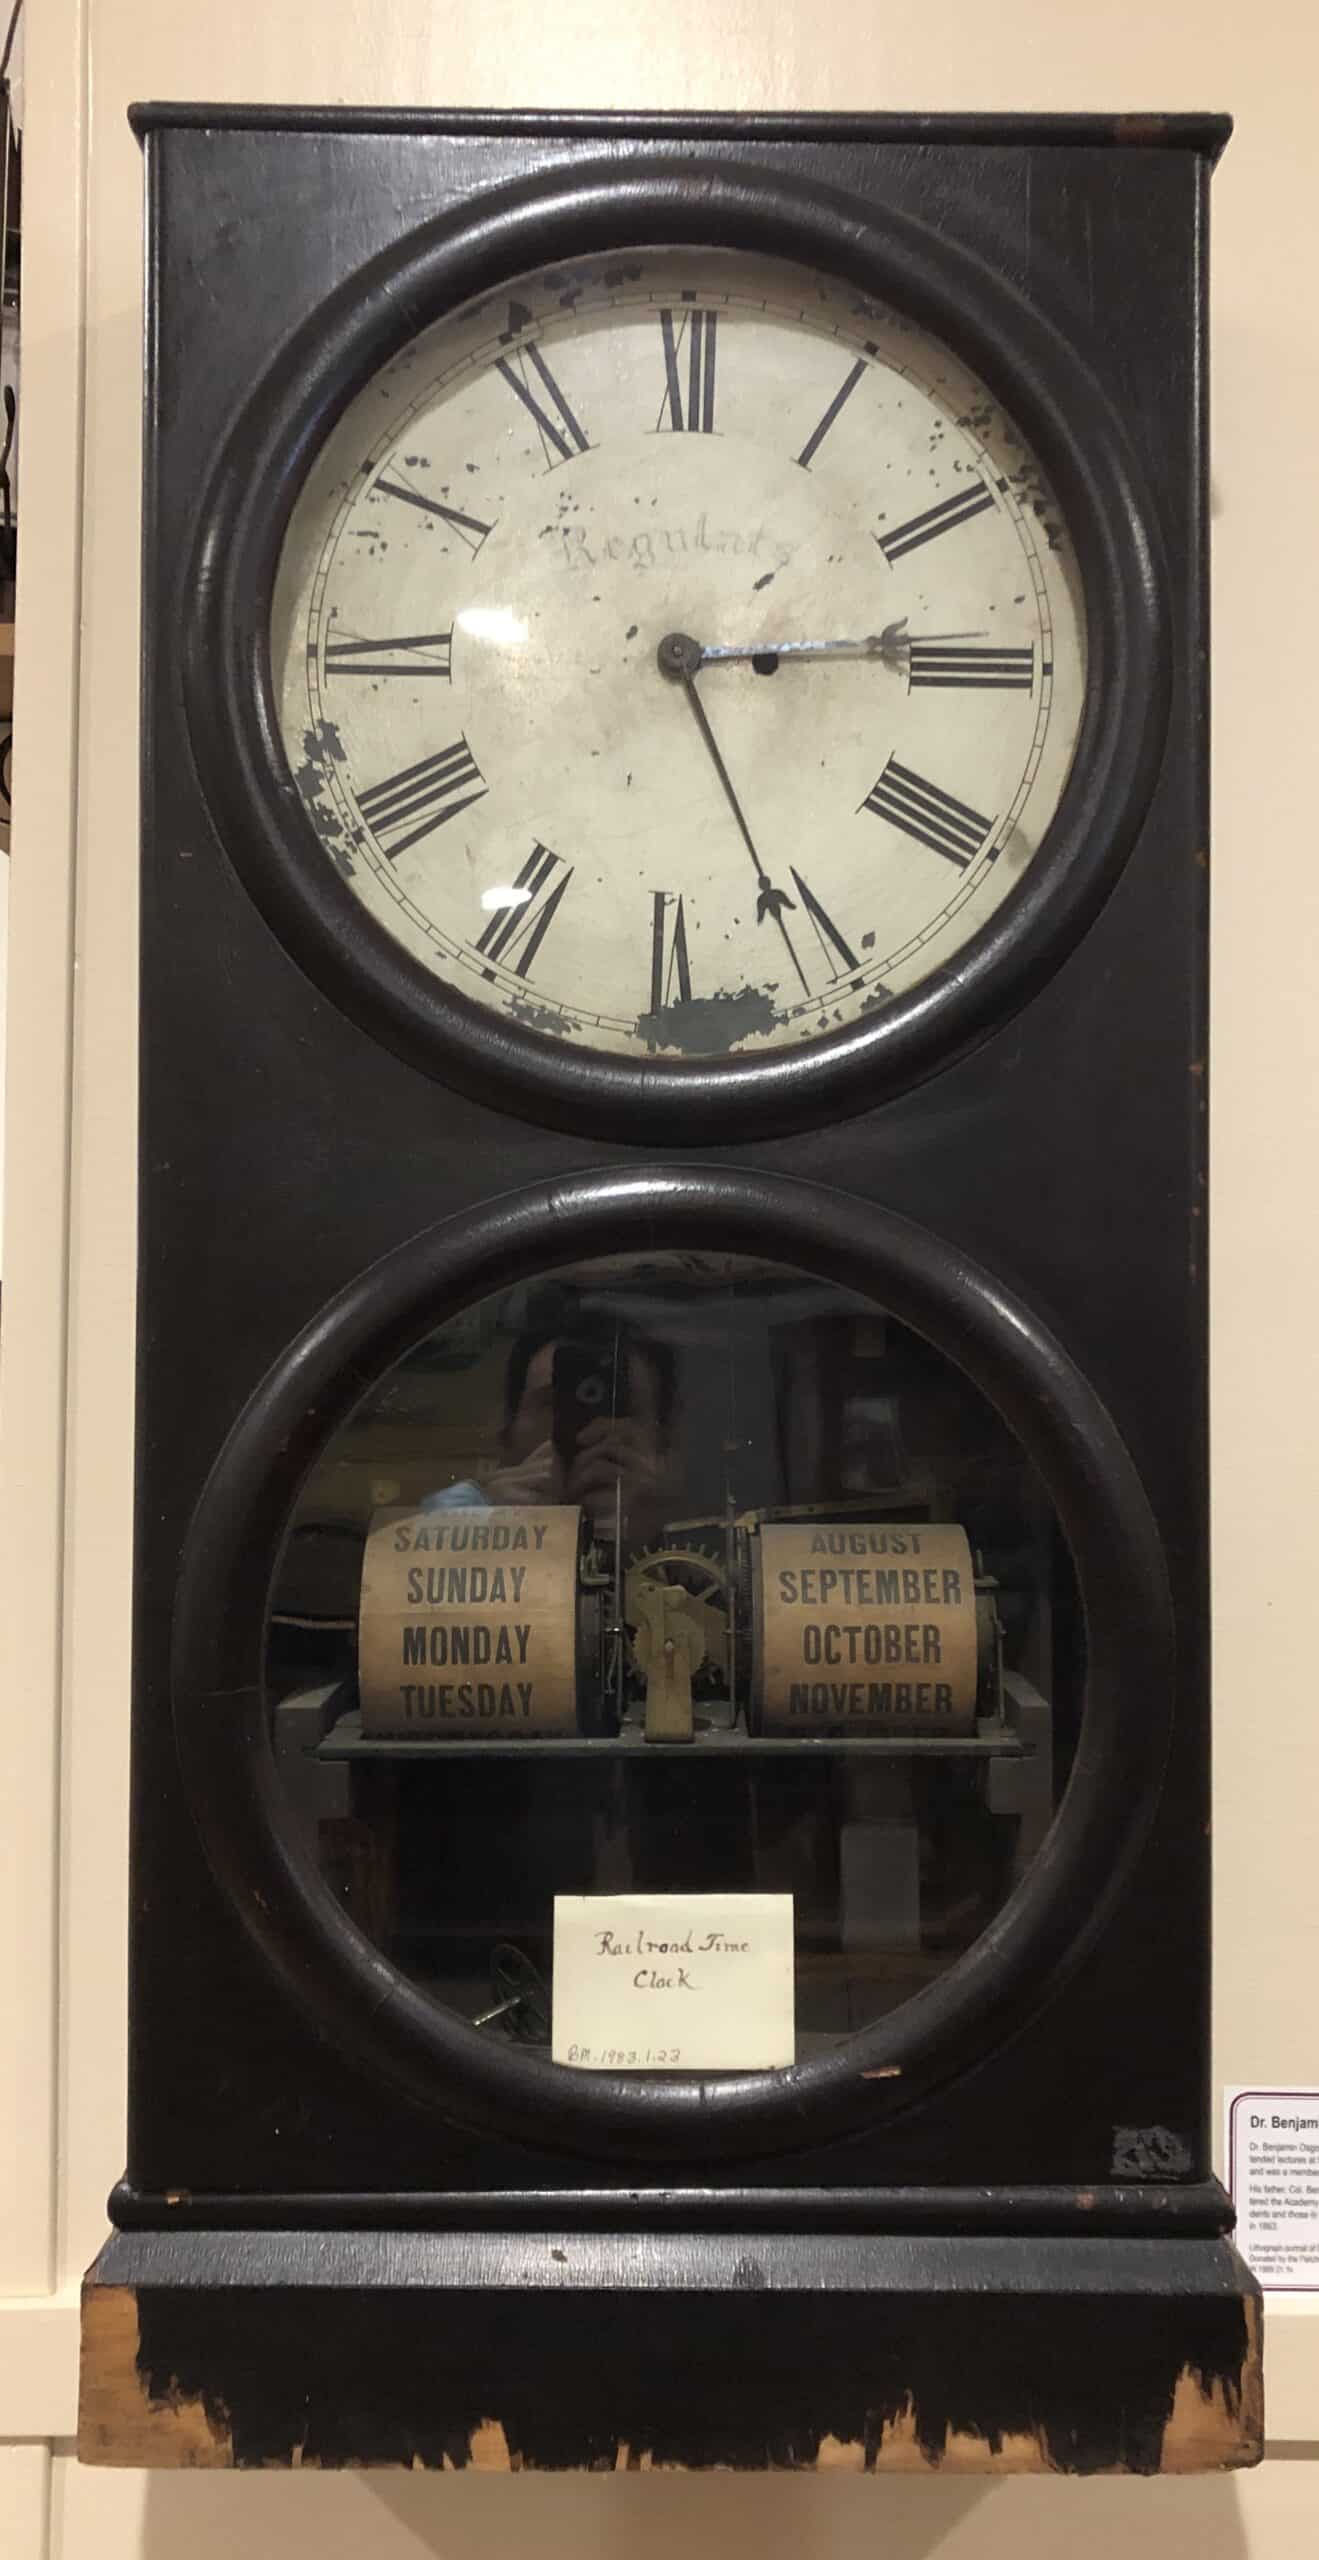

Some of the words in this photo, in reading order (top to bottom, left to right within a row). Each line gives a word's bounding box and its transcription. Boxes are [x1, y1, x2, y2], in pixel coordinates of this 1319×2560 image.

[646, 308, 725, 435] XII
[494, 341, 599, 476] XI
[791, 356, 878, 472] I
[366, 454, 499, 560] X
[871, 476, 1003, 569] II
[325, 622, 454, 688] IX
[907, 641, 1034, 696] III
[351, 731, 489, 871] VIII
[789, 864, 871, 984] V
[394, 1525, 548, 1552] SATURDAY
[811, 1533, 921, 1555] AUGUST
[407, 1566, 526, 1604] SUNDAY
[778, 1568, 962, 1605] SEPTEMBER
[403, 1625, 531, 1666] MONDAY
[803, 1624, 941, 1665] OCTOBER
[400, 1683, 533, 1718] TUESDAY
[790, 1683, 953, 1714] NOVEMBER
[594, 1930, 694, 1956] Railroad
[698, 1932, 750, 1953] Time
[1250, 2115, 1268, 2129] Dr.
